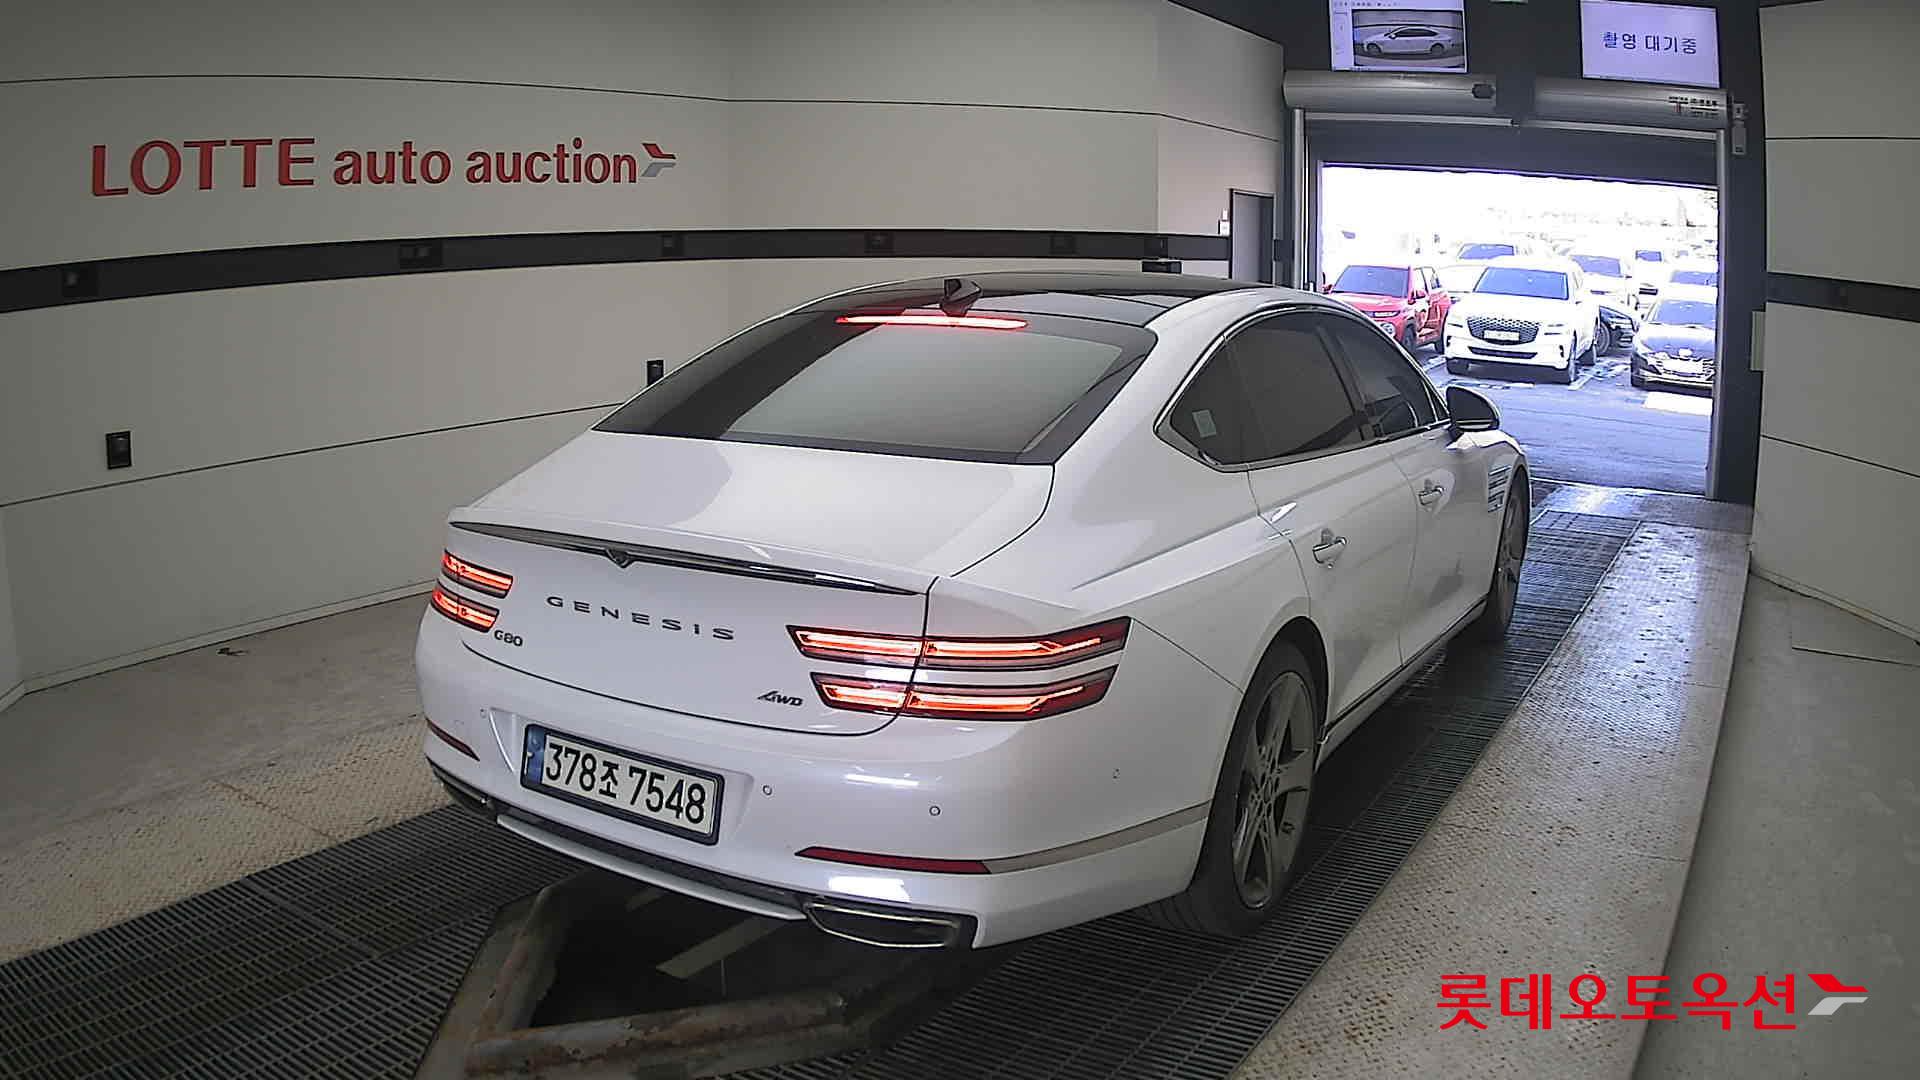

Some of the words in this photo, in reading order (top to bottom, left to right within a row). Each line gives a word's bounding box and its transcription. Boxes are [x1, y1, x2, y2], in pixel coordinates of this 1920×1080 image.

[1602, 31, 1636, 50] 촬영
[1645, 34, 1696, 55] 대기중
[92, 138, 315, 196] LOTTE
[333, 142, 451, 185] auto
[466, 138, 637, 185] auction
[494, 629, 523, 647] G80
[547, 596, 735, 641] GENESIS
[546, 743, 619, 799] 378조
[629, 766, 706, 824] 7548
